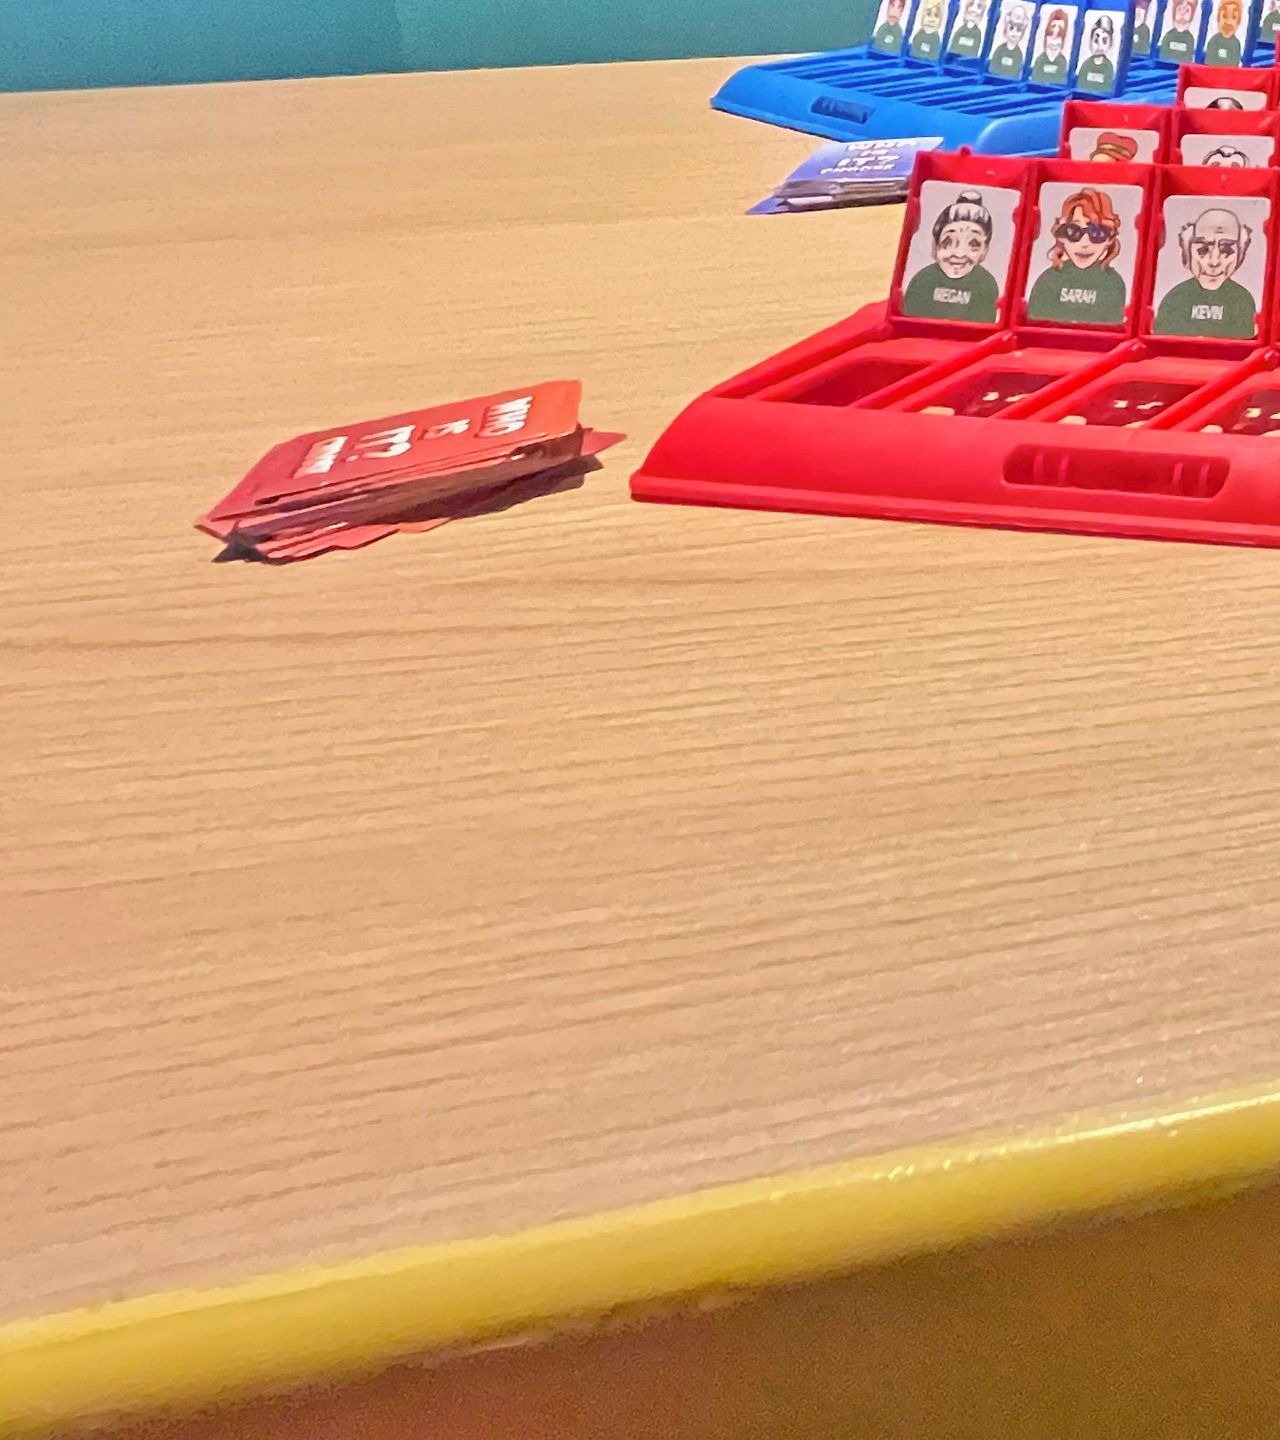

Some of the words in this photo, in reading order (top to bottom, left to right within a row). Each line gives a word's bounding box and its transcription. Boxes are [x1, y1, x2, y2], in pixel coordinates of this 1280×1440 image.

[933, 287, 972, 305] MEGAN
[1060, 287, 1098, 304] SARAH
[1190, 304, 1224, 321] KEVIN
